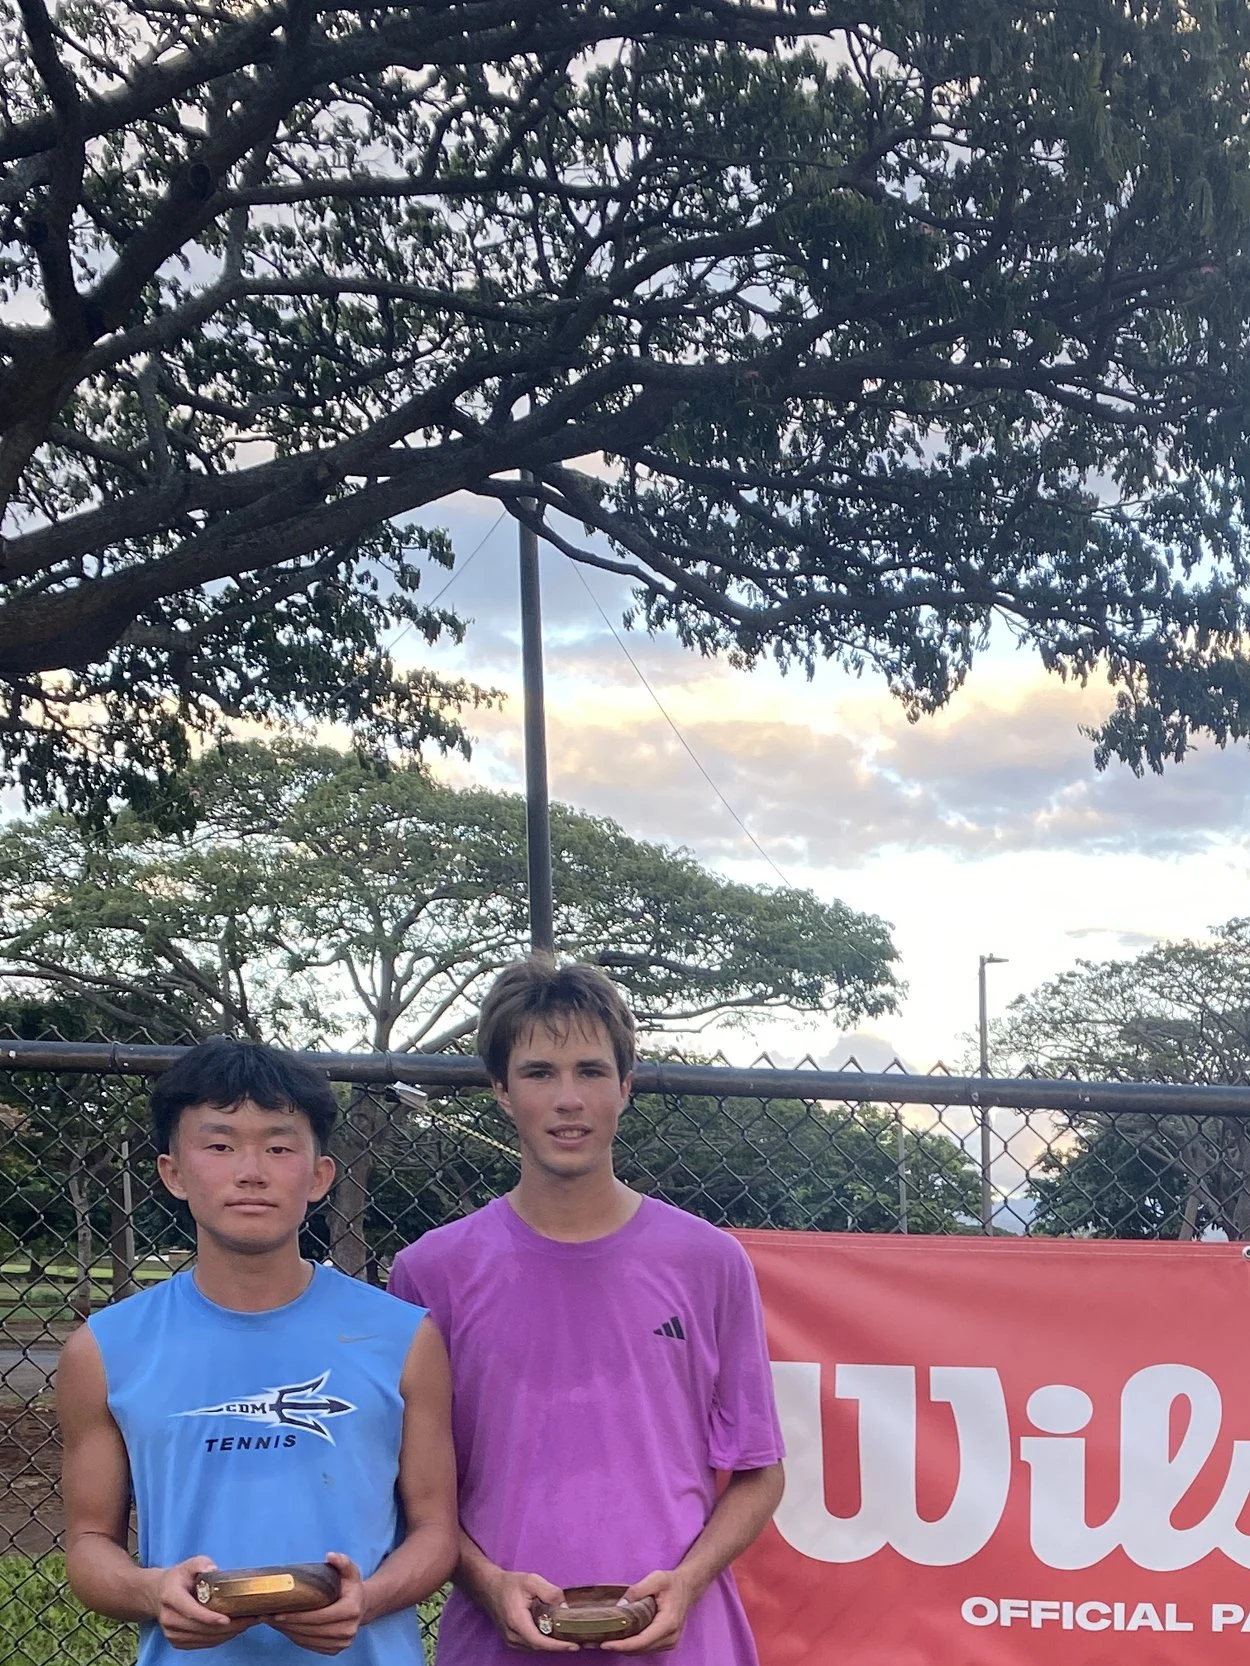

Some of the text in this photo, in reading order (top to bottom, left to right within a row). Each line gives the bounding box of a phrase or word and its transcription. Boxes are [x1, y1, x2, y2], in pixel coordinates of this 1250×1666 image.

[225, 1403, 267, 1415] CDM
[205, 1435, 296, 1452] TENNIS
[961, 1596, 1194, 1631] OFFICIAL
